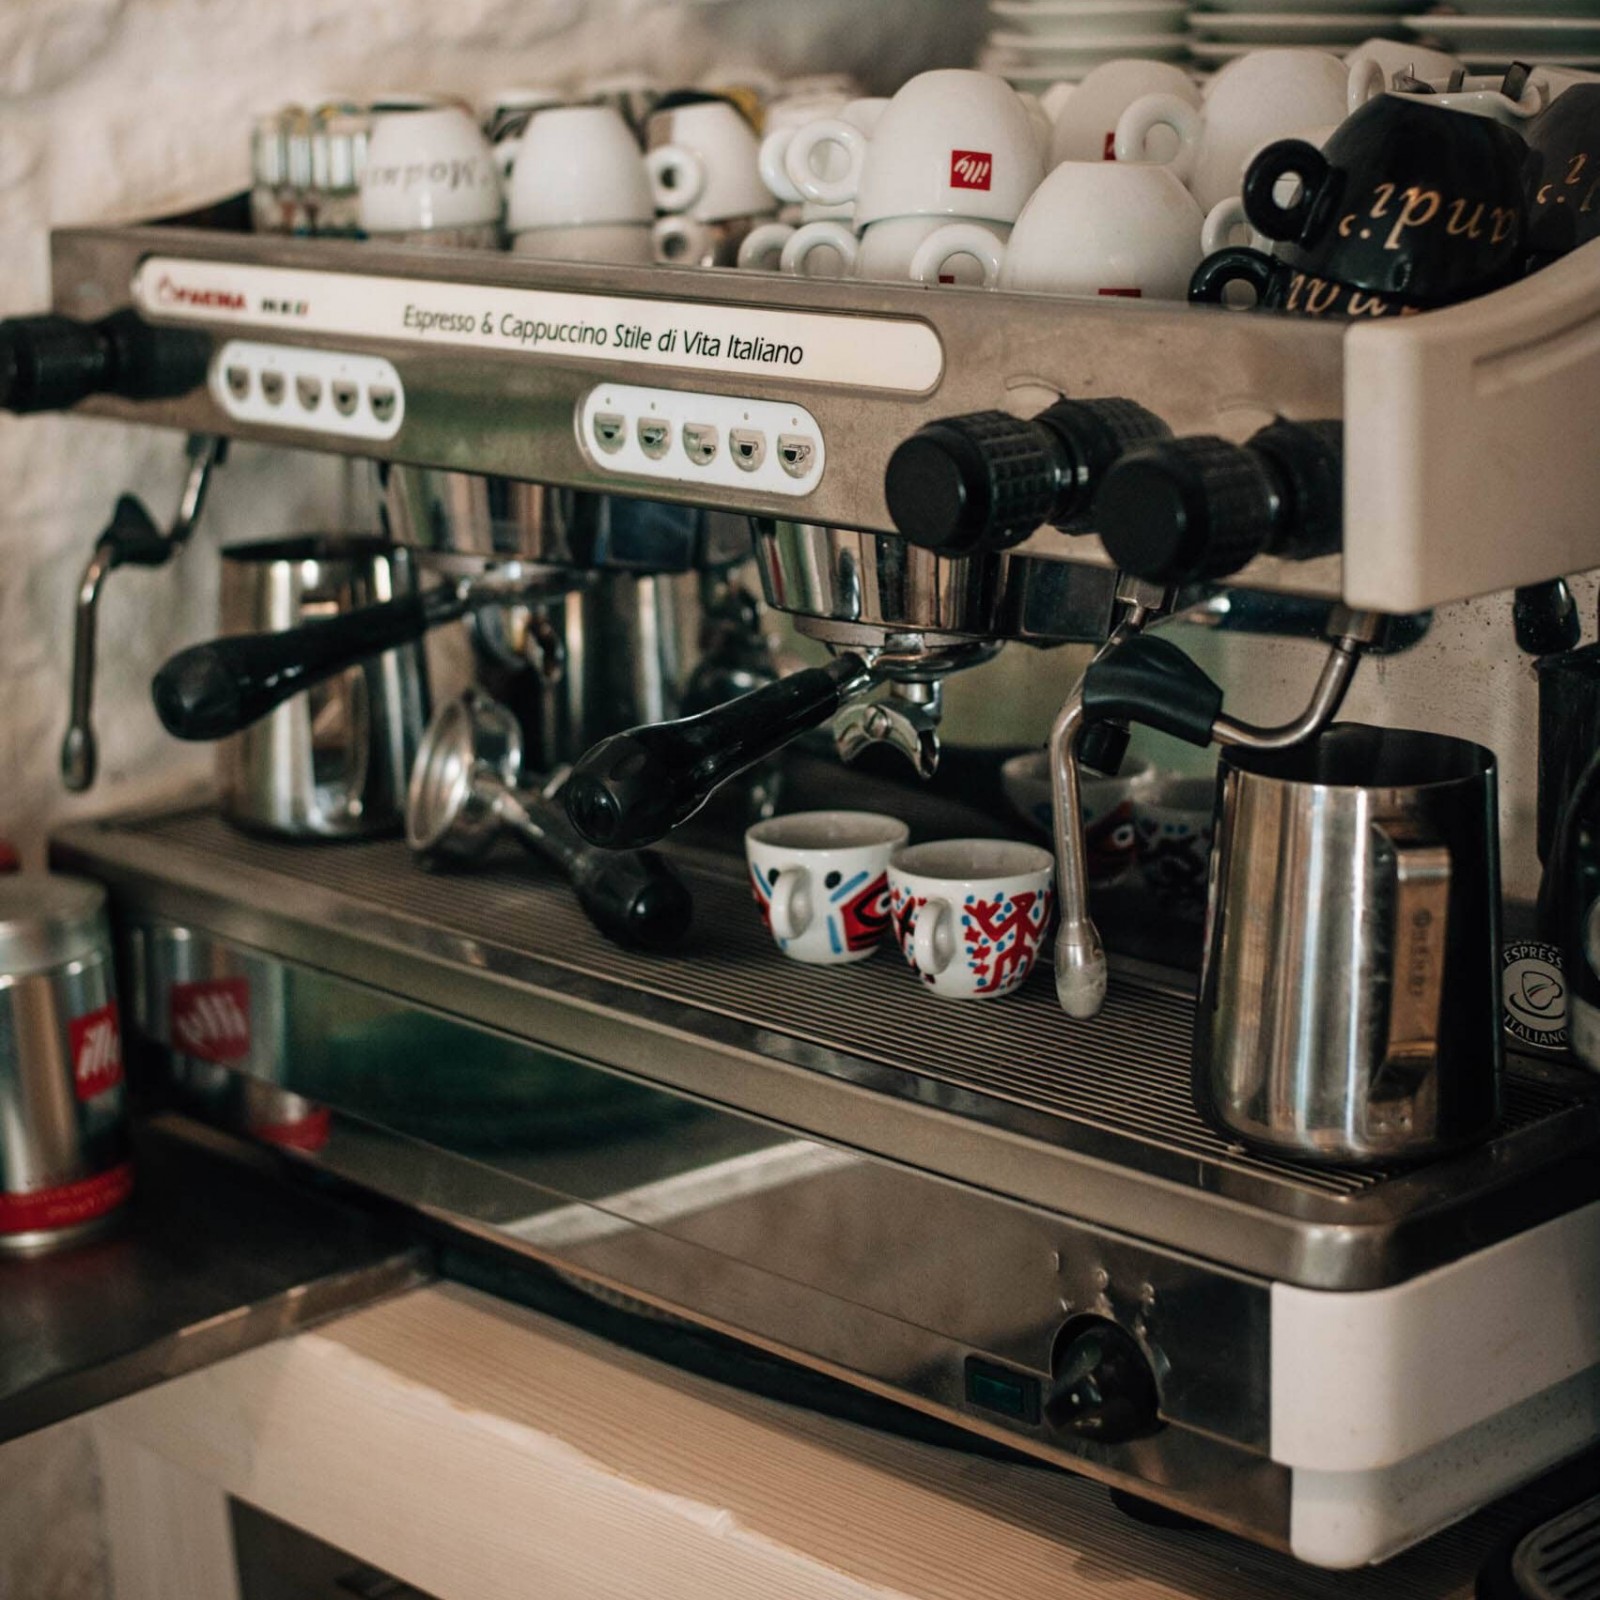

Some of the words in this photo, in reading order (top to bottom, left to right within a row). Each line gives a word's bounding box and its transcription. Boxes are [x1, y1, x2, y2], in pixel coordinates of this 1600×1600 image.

[953, 154, 990, 184] illy
[403, 304, 476, 334] Espresso
[481, 312, 493, 332] &
[500, 314, 607, 347] Cappuccino
[613, 323, 652, 352] Stile
[657, 327, 676, 354] di
[683, 330, 721, 357] Vita
[726, 335, 804, 366] Italiano
